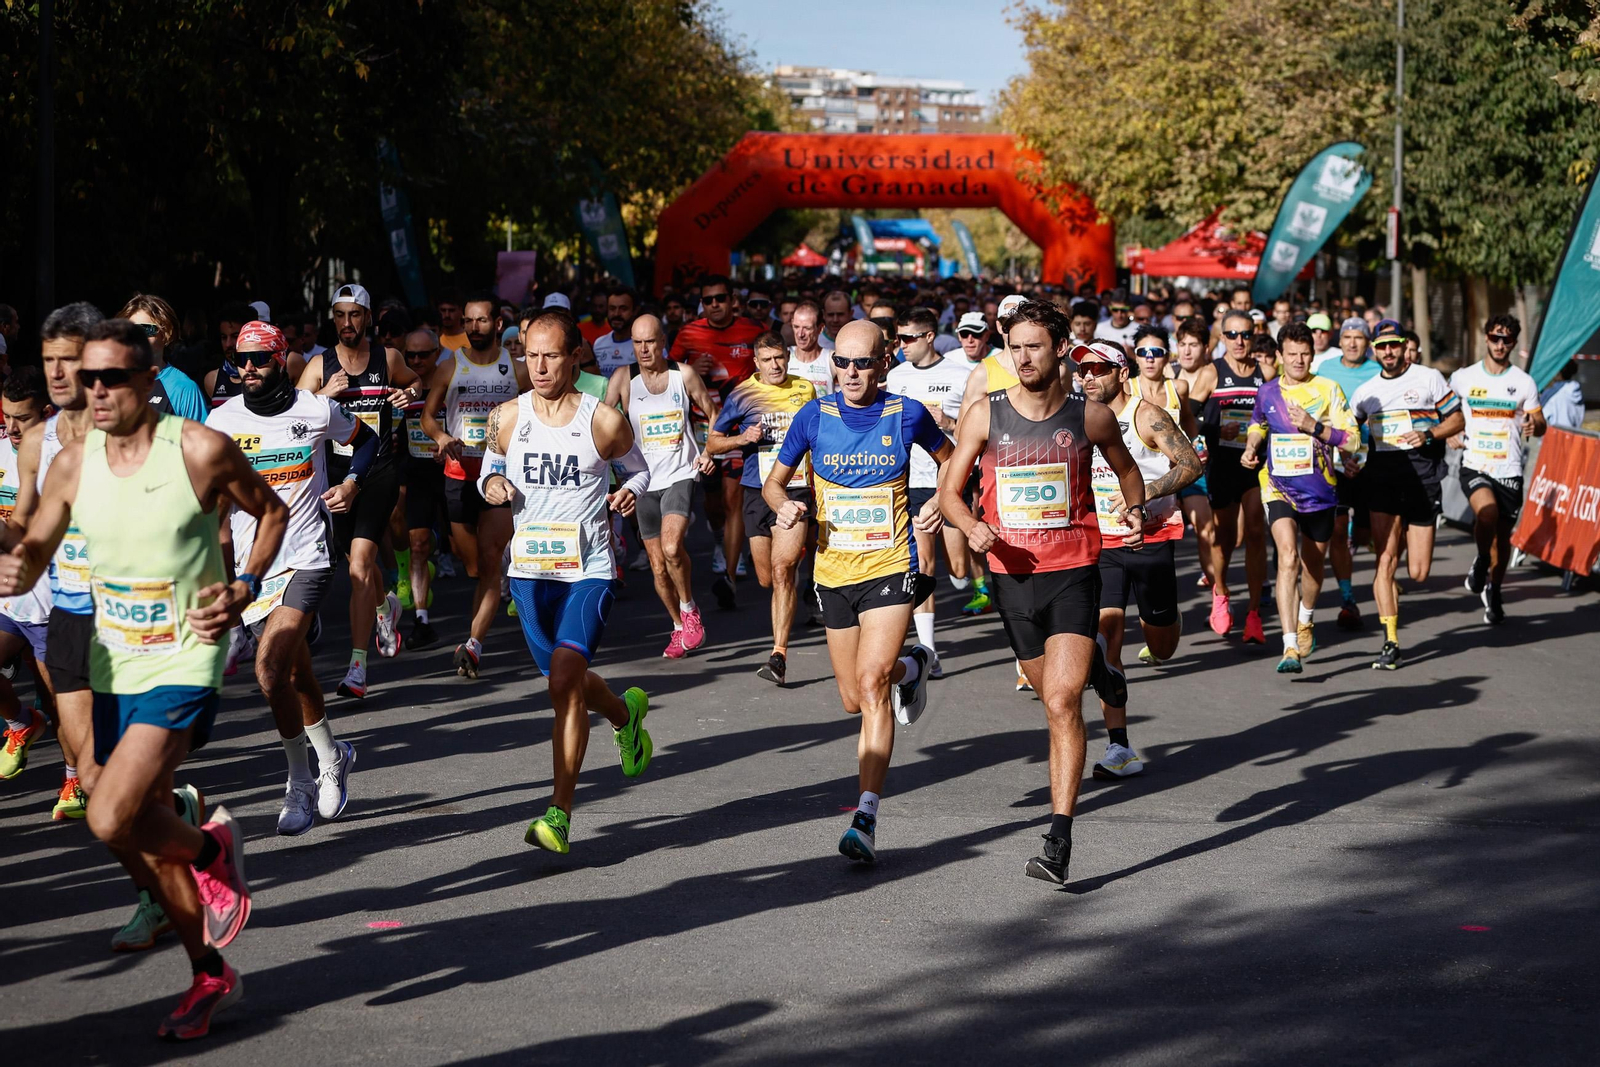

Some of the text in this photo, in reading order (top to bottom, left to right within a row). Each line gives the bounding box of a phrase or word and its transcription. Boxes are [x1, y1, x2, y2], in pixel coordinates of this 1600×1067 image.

[784, 147, 995, 171] Universidad
[787, 174, 989, 196] de Granada
[693, 170, 763, 231] Deportes
[646, 422, 681, 436] 1151
[1275, 447, 1308, 458] 1145
[1478, 440, 1503, 449] 528
[823, 450, 896, 470] agustinos
[262, 467, 313, 483] ERSIDAD
[523, 453, 581, 487] ENA
[833, 468, 885, 476] GRANADA
[1010, 484, 1057, 503] 750
[832, 507, 887, 524] 1489
[525, 540, 567, 555] 315
[105, 598, 167, 623] 1062
